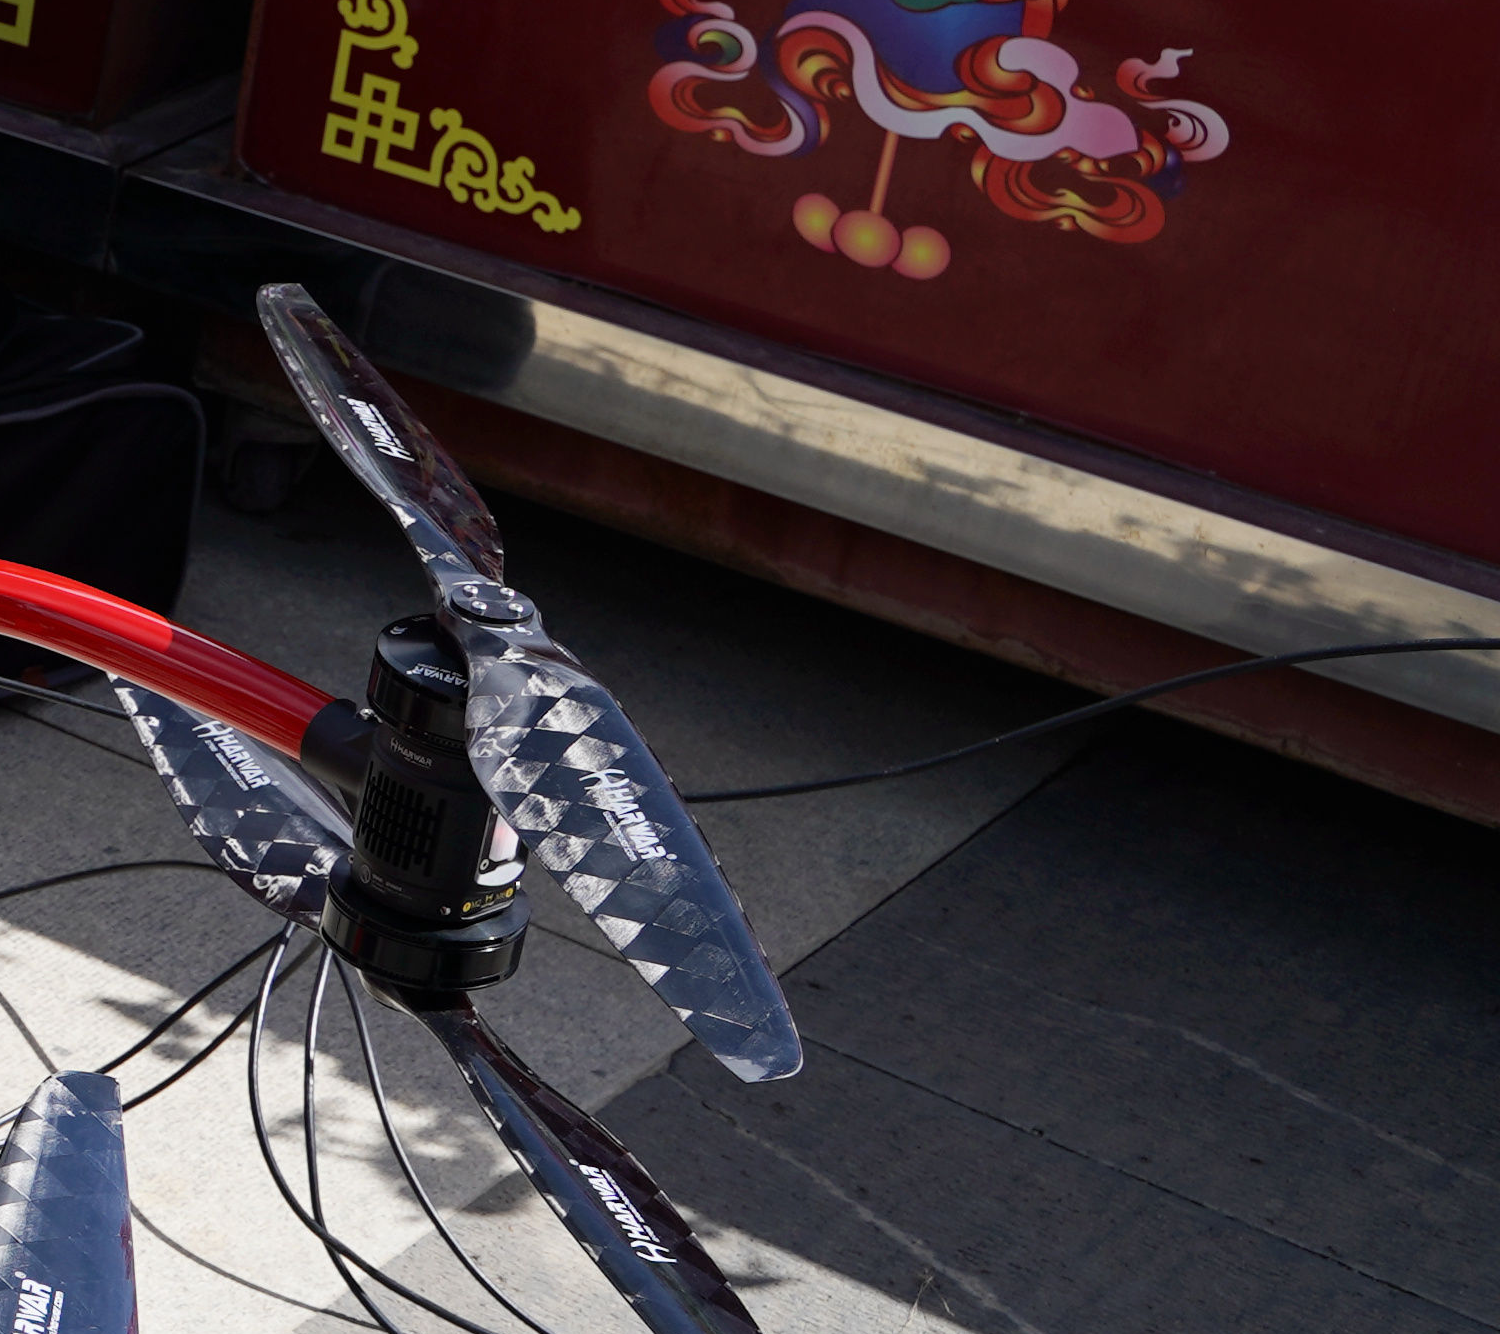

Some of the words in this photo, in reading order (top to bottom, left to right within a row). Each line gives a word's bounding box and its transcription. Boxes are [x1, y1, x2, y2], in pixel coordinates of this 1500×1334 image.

[213, 734, 271, 789] HARWAR
[604, 788, 667, 860] HARWAR
[579, 1164, 652, 1240] HARWAR
